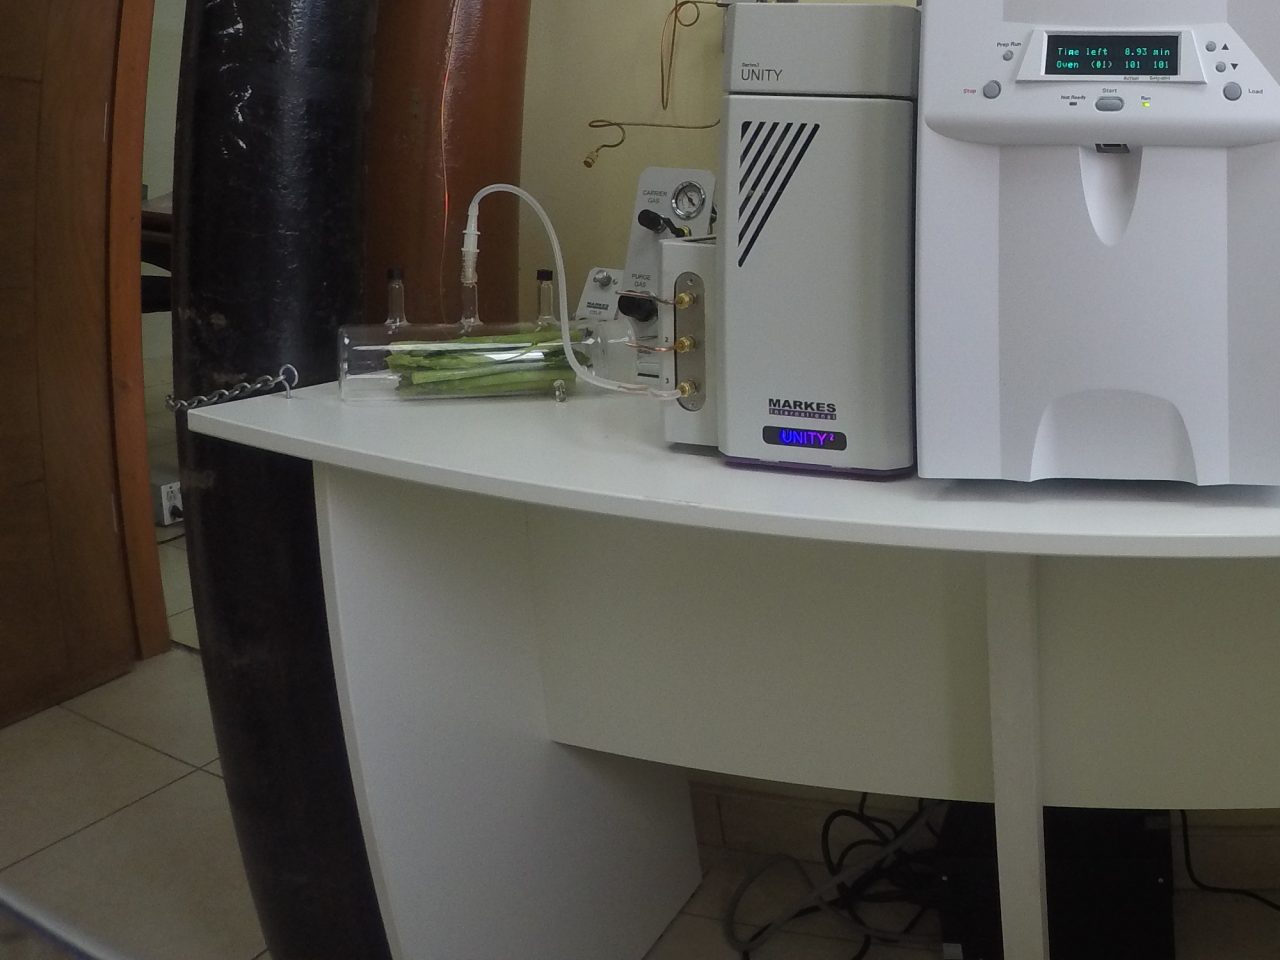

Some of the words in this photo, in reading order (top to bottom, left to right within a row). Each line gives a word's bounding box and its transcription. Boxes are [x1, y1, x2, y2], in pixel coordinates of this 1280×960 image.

[1057, 47, 1080, 56] Time
[1086, 47, 1108, 56] left
[1124, 47, 1148, 56] 8.93
[1152, 48, 1170, 56] min
[1056, 60, 1079, 69] Oven
[741, 69, 783, 81] UNITY
[642, 189, 668, 197] CARRIER
[631, 273, 652, 281] PURGE
[768, 398, 837, 413] MARKES
